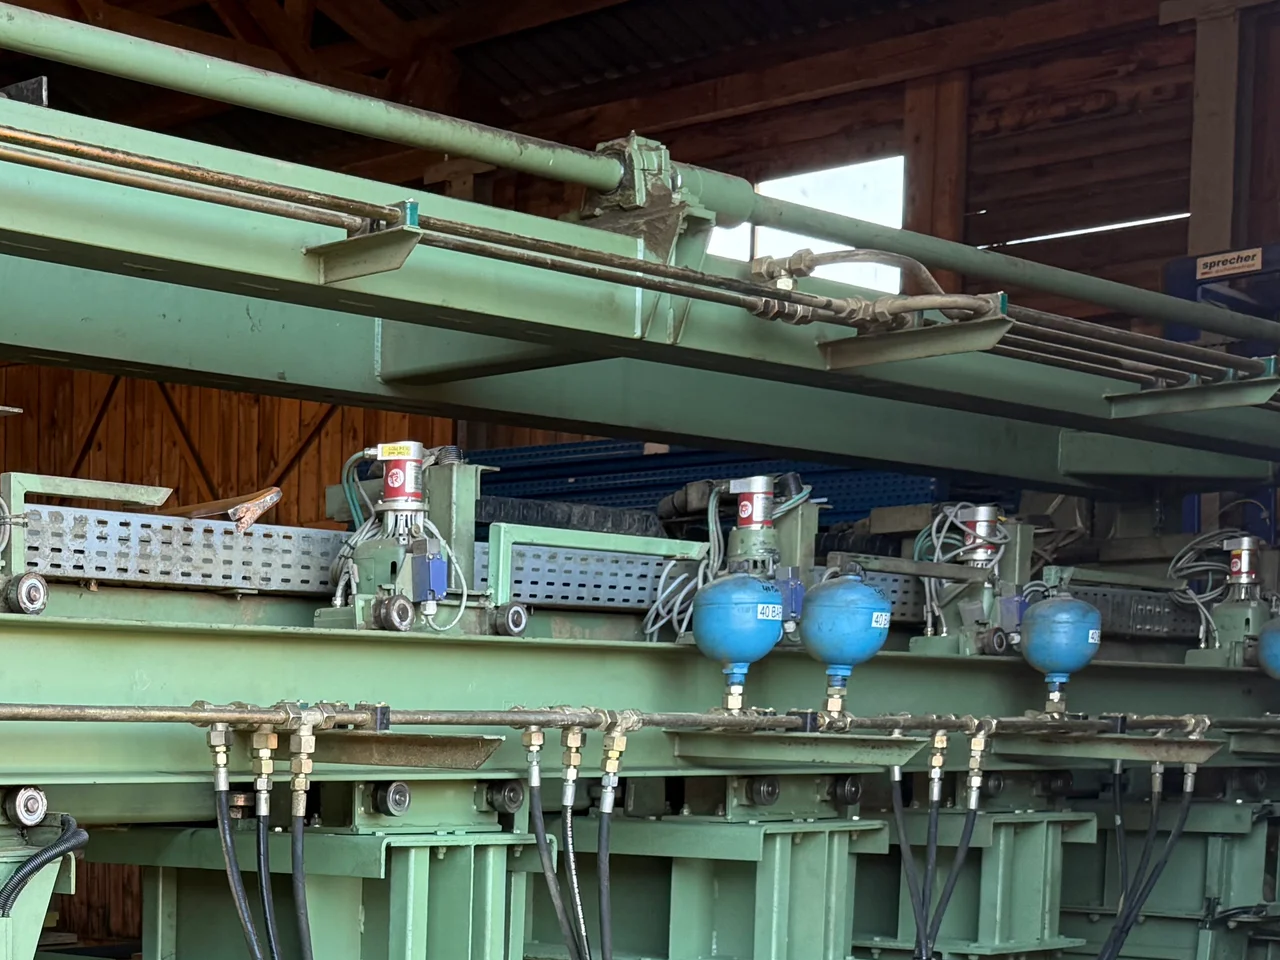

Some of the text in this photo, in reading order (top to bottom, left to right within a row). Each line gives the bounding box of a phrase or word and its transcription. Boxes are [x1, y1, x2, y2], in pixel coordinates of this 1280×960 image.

[1202, 253, 1257, 270] sprecher
[759, 606, 770, 618] 40
[874, 614, 883, 625] 40
